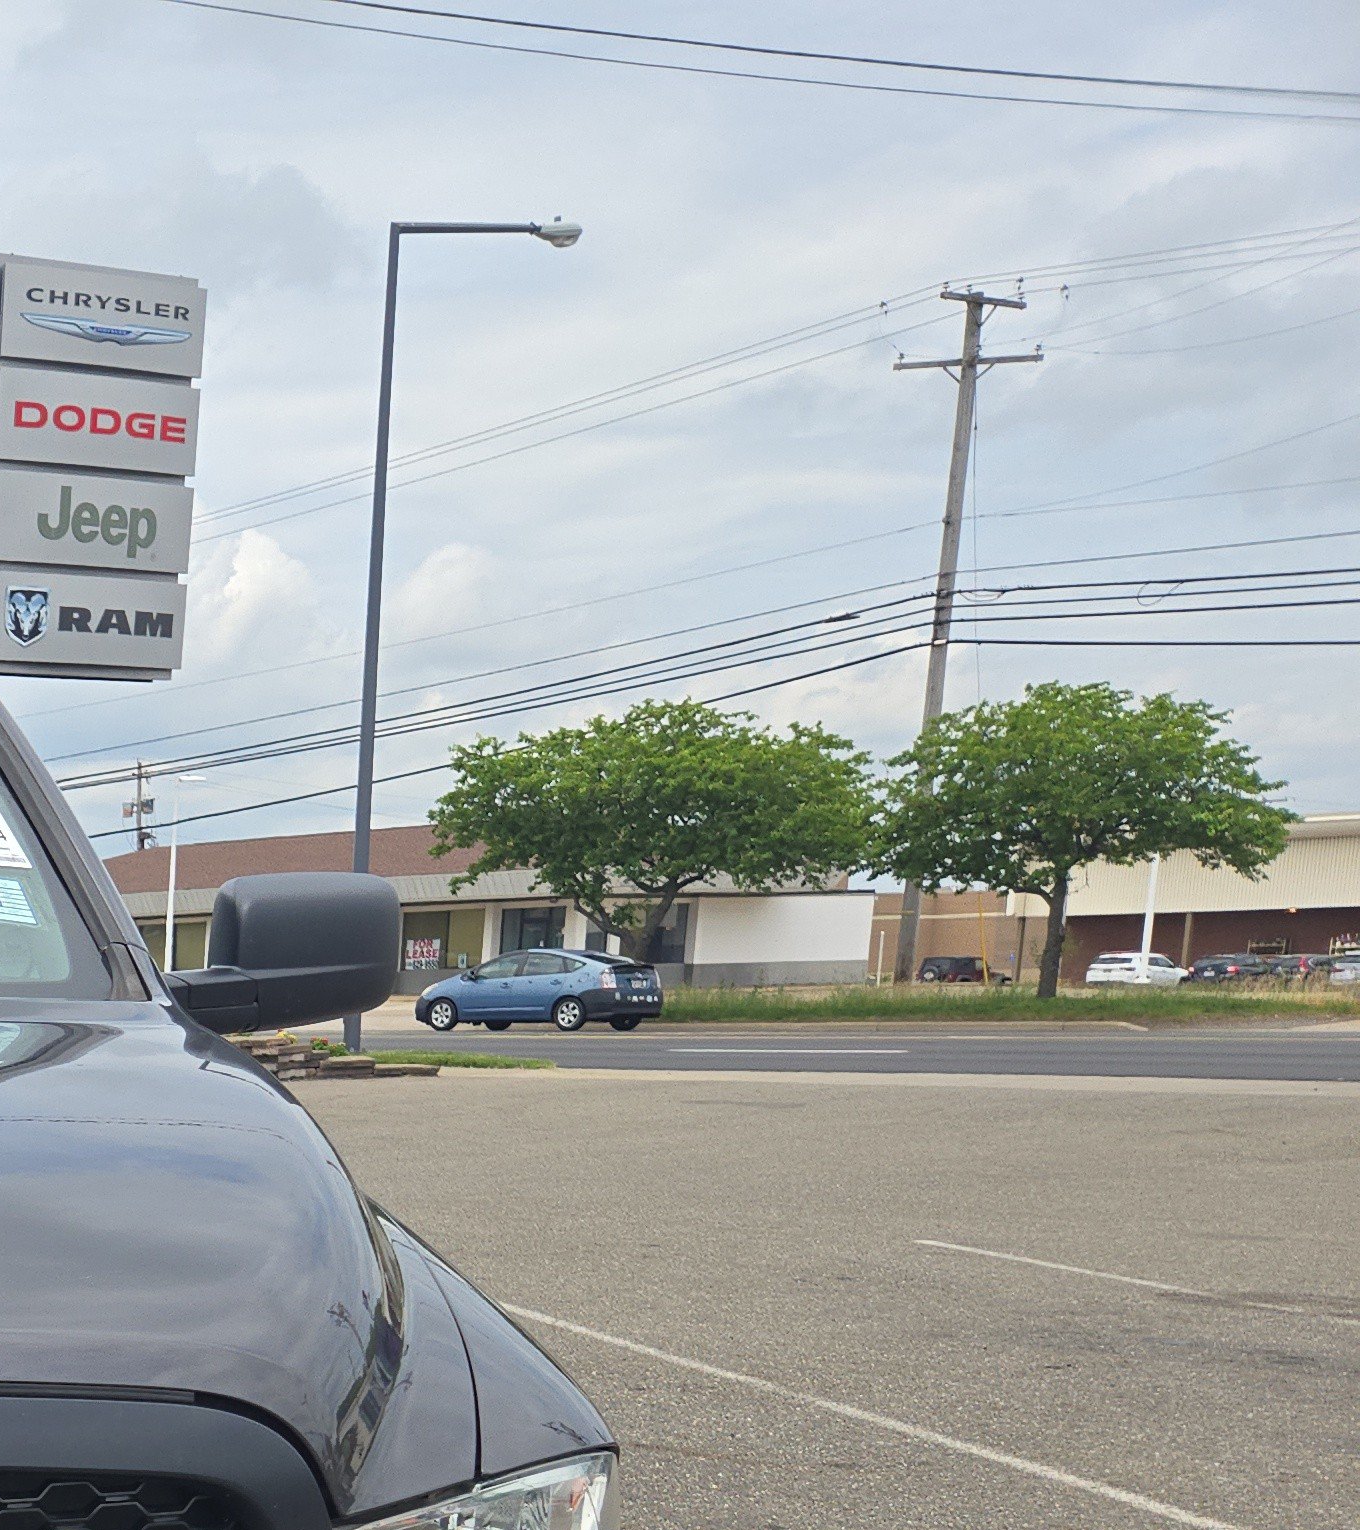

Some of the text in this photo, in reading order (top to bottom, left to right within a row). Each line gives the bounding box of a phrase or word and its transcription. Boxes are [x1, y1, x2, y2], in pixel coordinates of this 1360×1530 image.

[26, 287, 190, 321] CHRYSLER
[13, 401, 187, 444] DODGE
[37, 485, 157, 558] Jeep
[57, 606, 173, 639] RAM
[405, 949, 438, 959] LEASE
[413, 938, 433, 948] FOR
